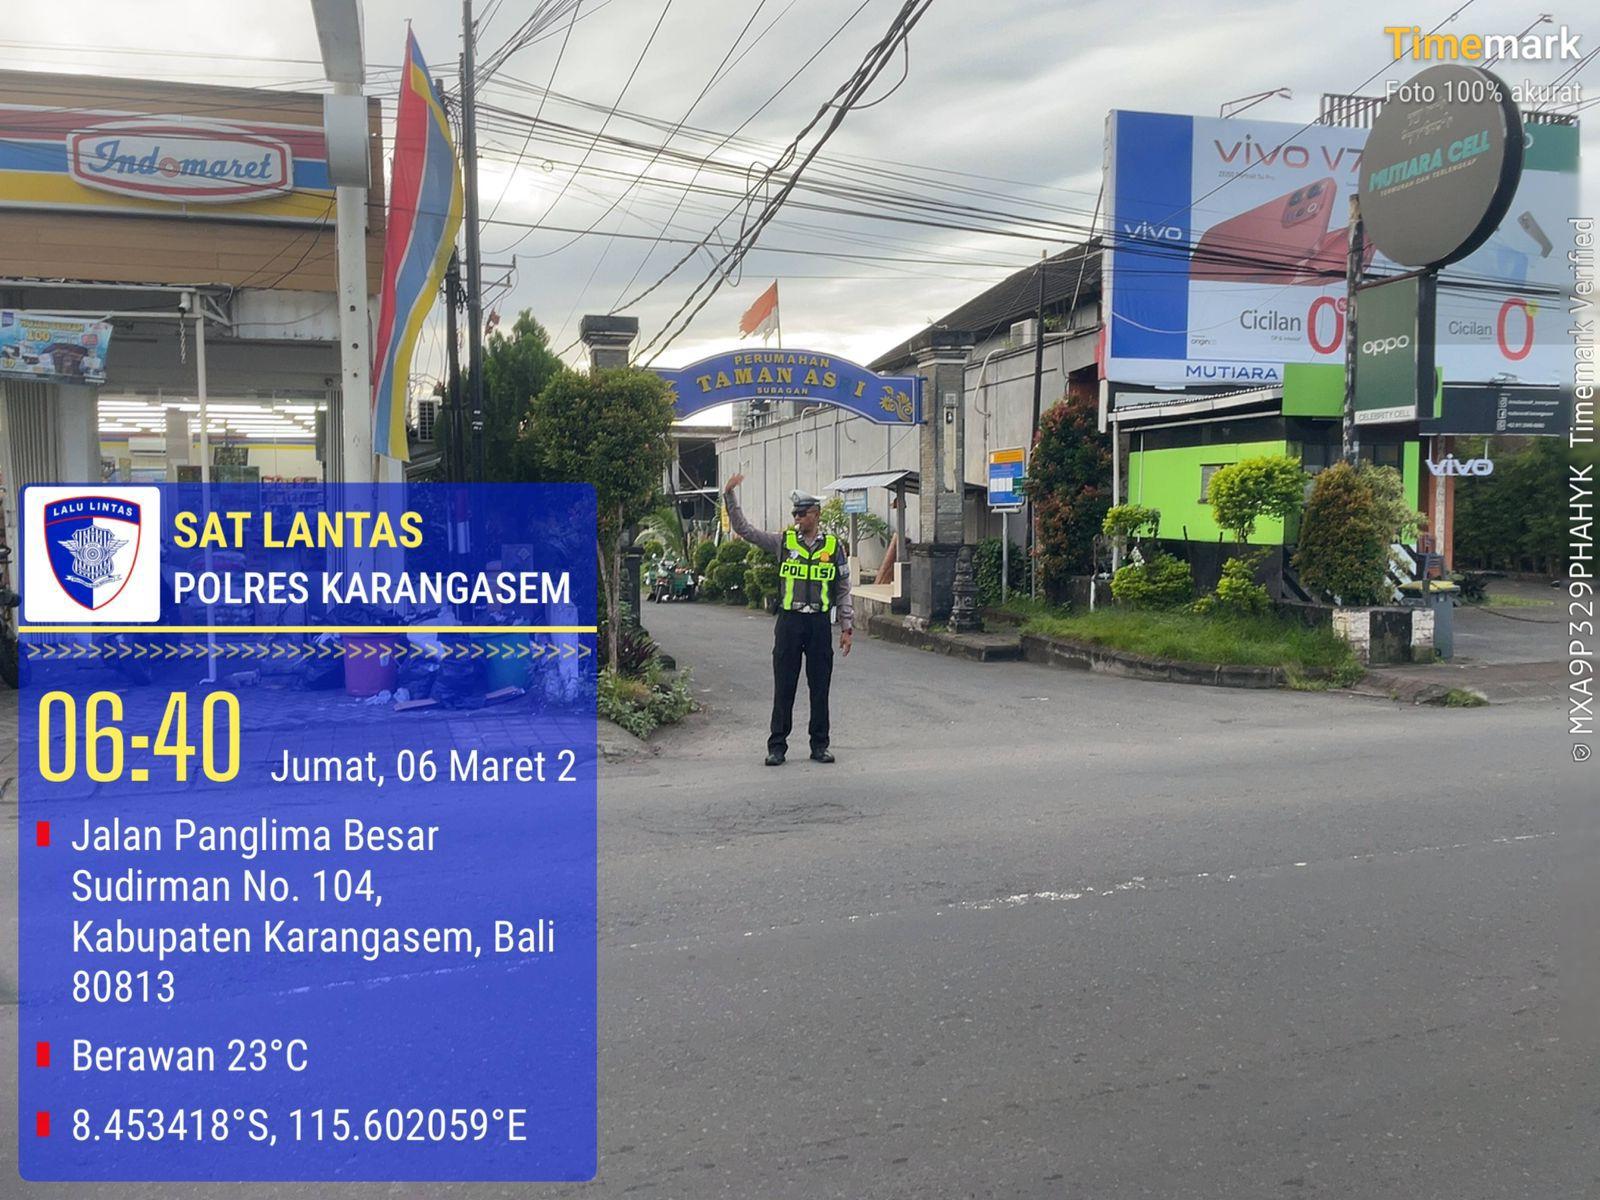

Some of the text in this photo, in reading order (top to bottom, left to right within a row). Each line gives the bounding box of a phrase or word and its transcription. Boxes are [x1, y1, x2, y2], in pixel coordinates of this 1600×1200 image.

[88, 139, 272, 179] Indomaret
[1213, 134, 1310, 169] vivo
[1368, 147, 1444, 193] MUTIARA
[1447, 130, 1490, 163] CELL
[1124, 221, 1182, 240] vivo
[1239, 309, 1302, 332] Cicilan
[1448, 320, 1493, 337] Cicilan
[1362, 334, 1410, 356] oppo
[734, 353, 830, 368] PERUMAHAN
[696, 366, 793, 394] TAMAN
[1185, 364, 1279, 381] MUTIARA
[756, 386, 809, 396] SUBAGAN
